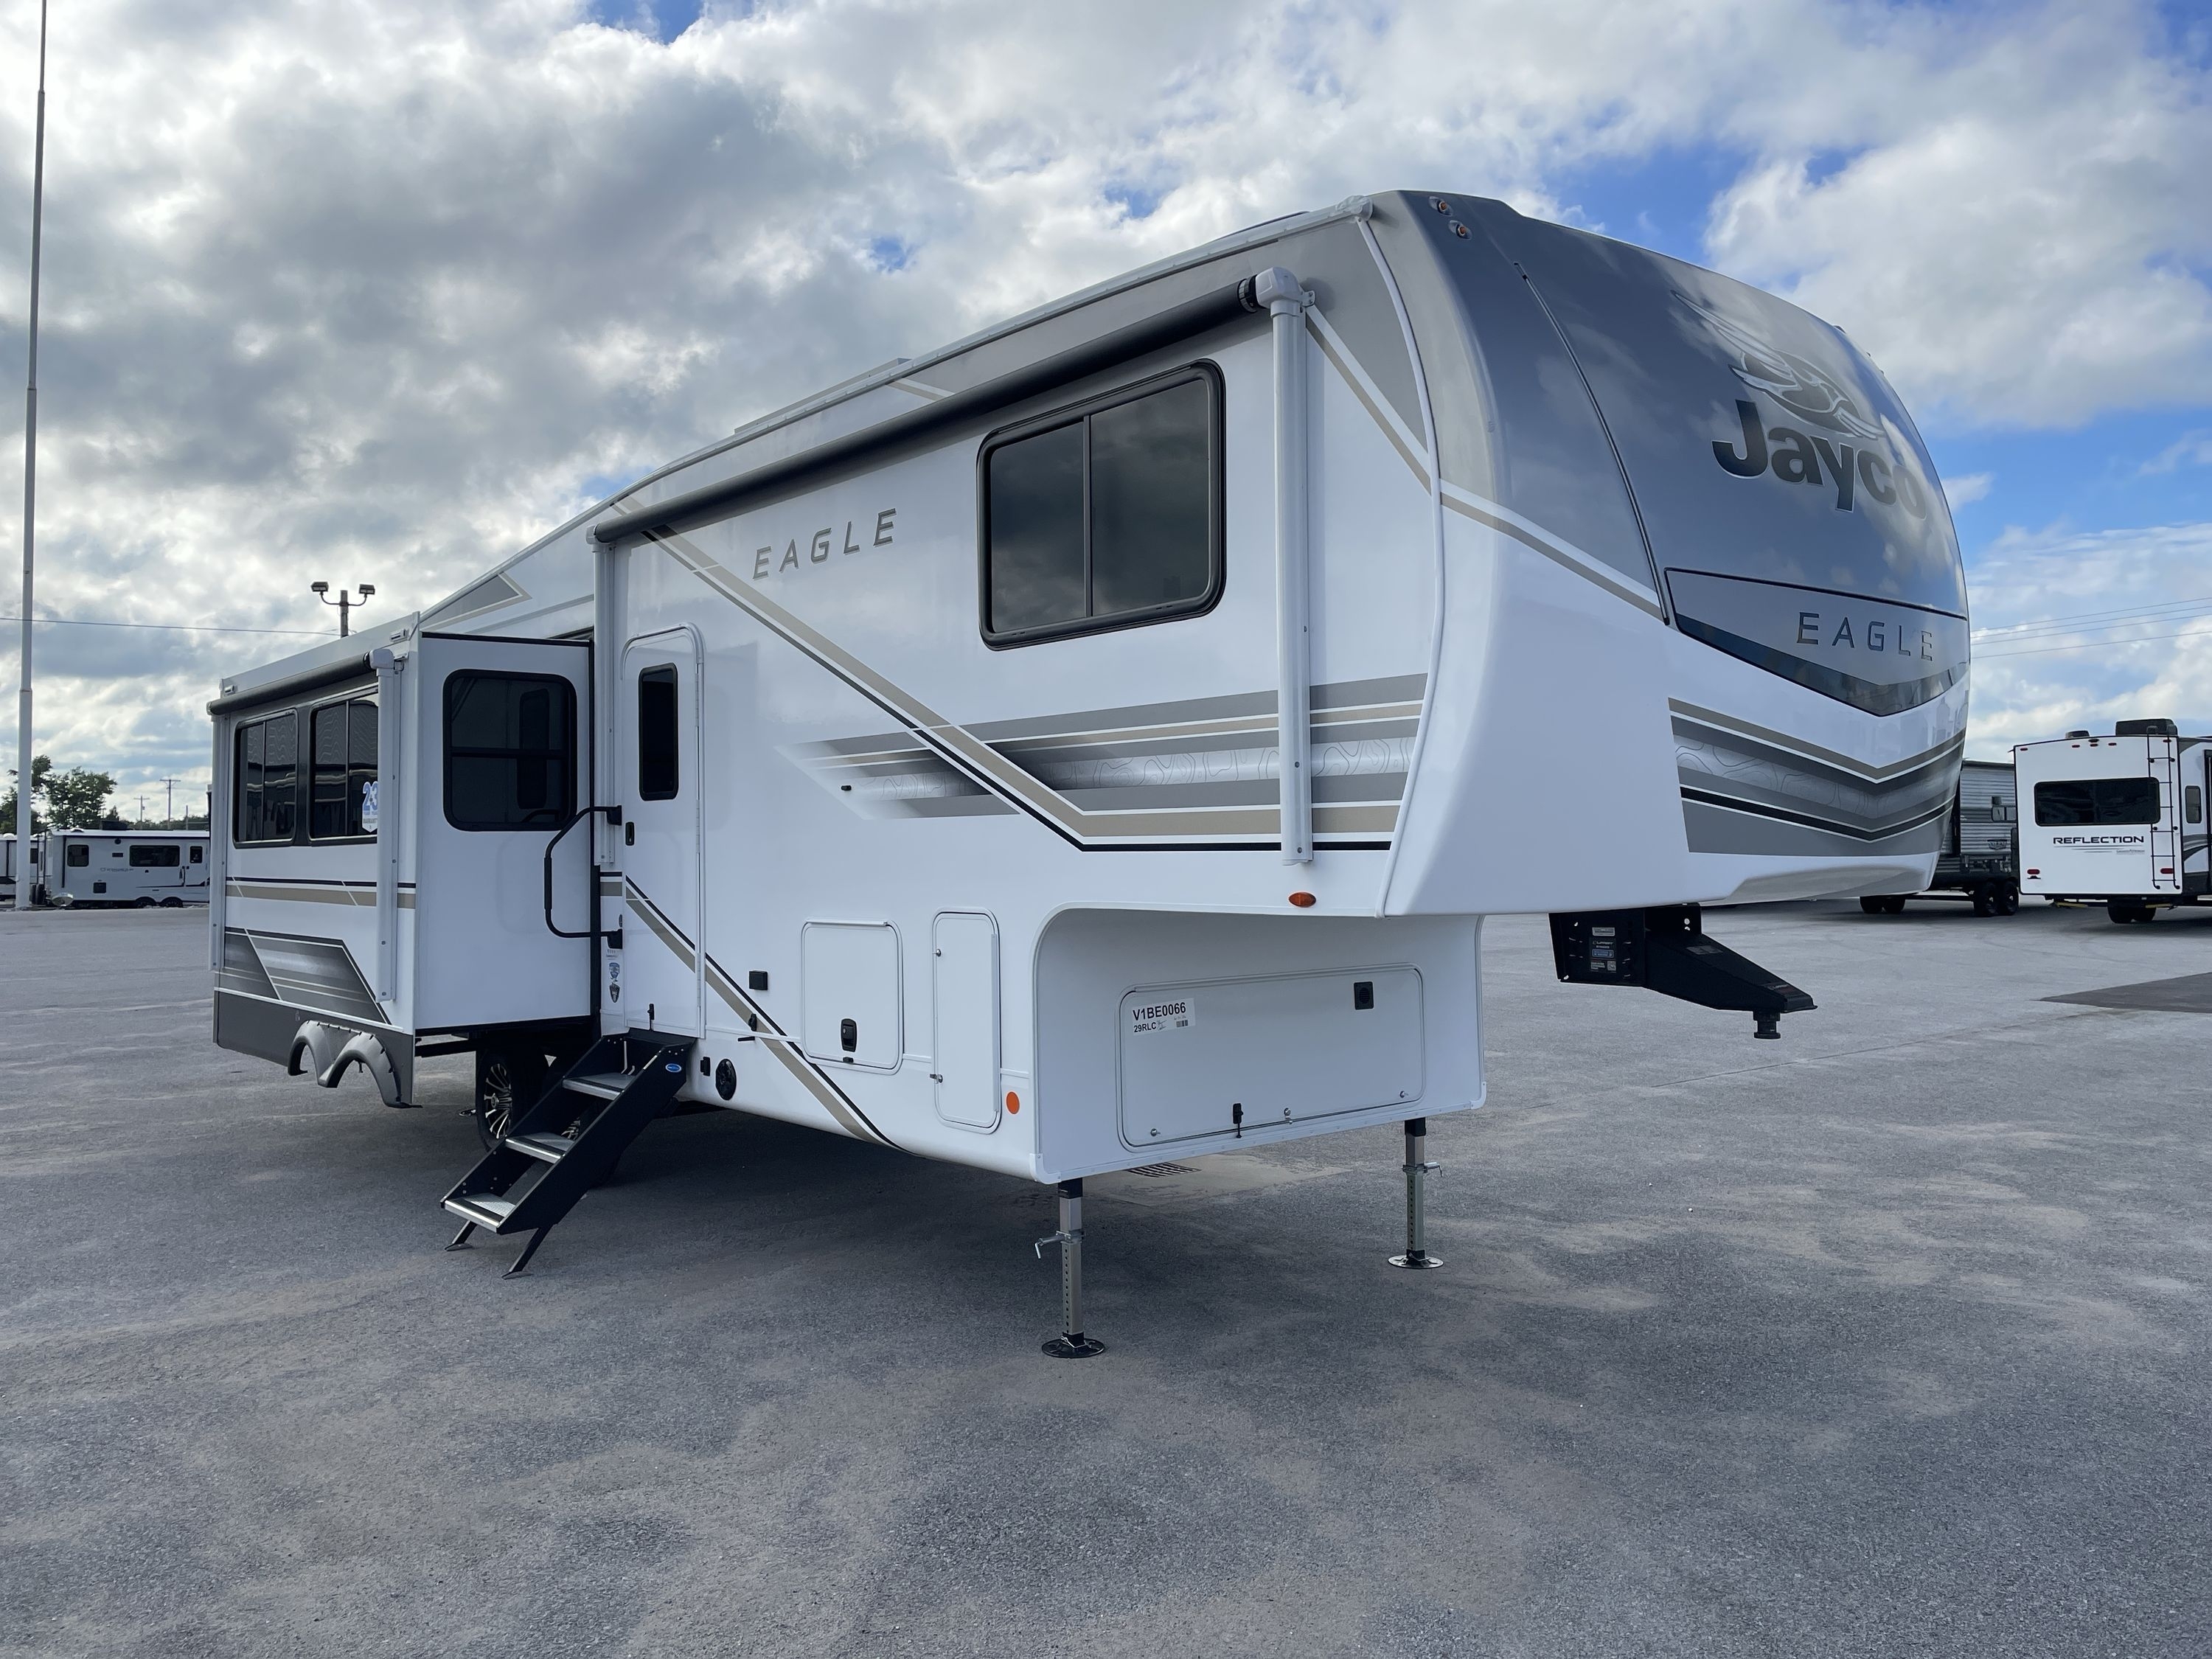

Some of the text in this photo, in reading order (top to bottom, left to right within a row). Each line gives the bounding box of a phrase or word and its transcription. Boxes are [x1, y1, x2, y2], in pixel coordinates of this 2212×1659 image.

[1711, 399, 1927, 520] Jayco
[753, 508, 897, 580] EAGLE
[1796, 611, 1933, 661] EAGLE
[2053, 835, 2144, 844] REFLECTION
[1133, 1002, 1186, 1020] V1BE0066
[1133, 1022, 1157, 1032] 29RLC
